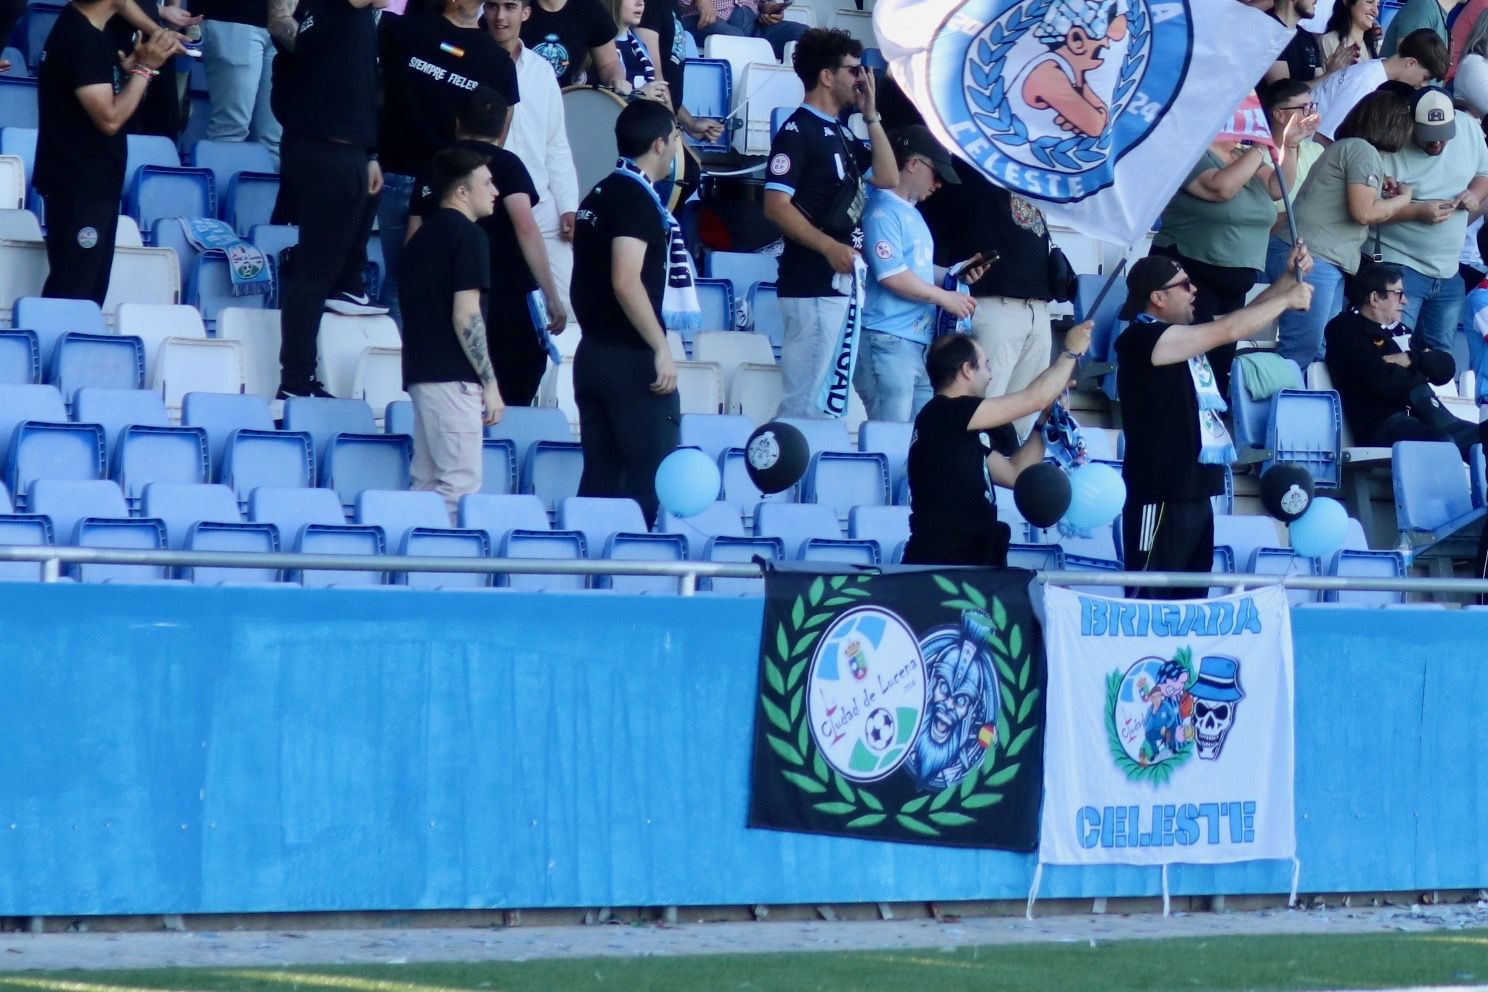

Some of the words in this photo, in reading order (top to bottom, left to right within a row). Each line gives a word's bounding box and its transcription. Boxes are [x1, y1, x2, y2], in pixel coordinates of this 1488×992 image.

[408, 56, 448, 81] SIEMPRE
[1126, 91, 1162, 123] 24
[951, 120, 1085, 197] CELESTE
[823, 303, 857, 419] BRIGAD
[1077, 596, 1263, 638] BRIGADA
[863, 688, 876, 708] de
[877, 659, 918, 695] Lucena
[1075, 800, 1257, 850] CELESTE
